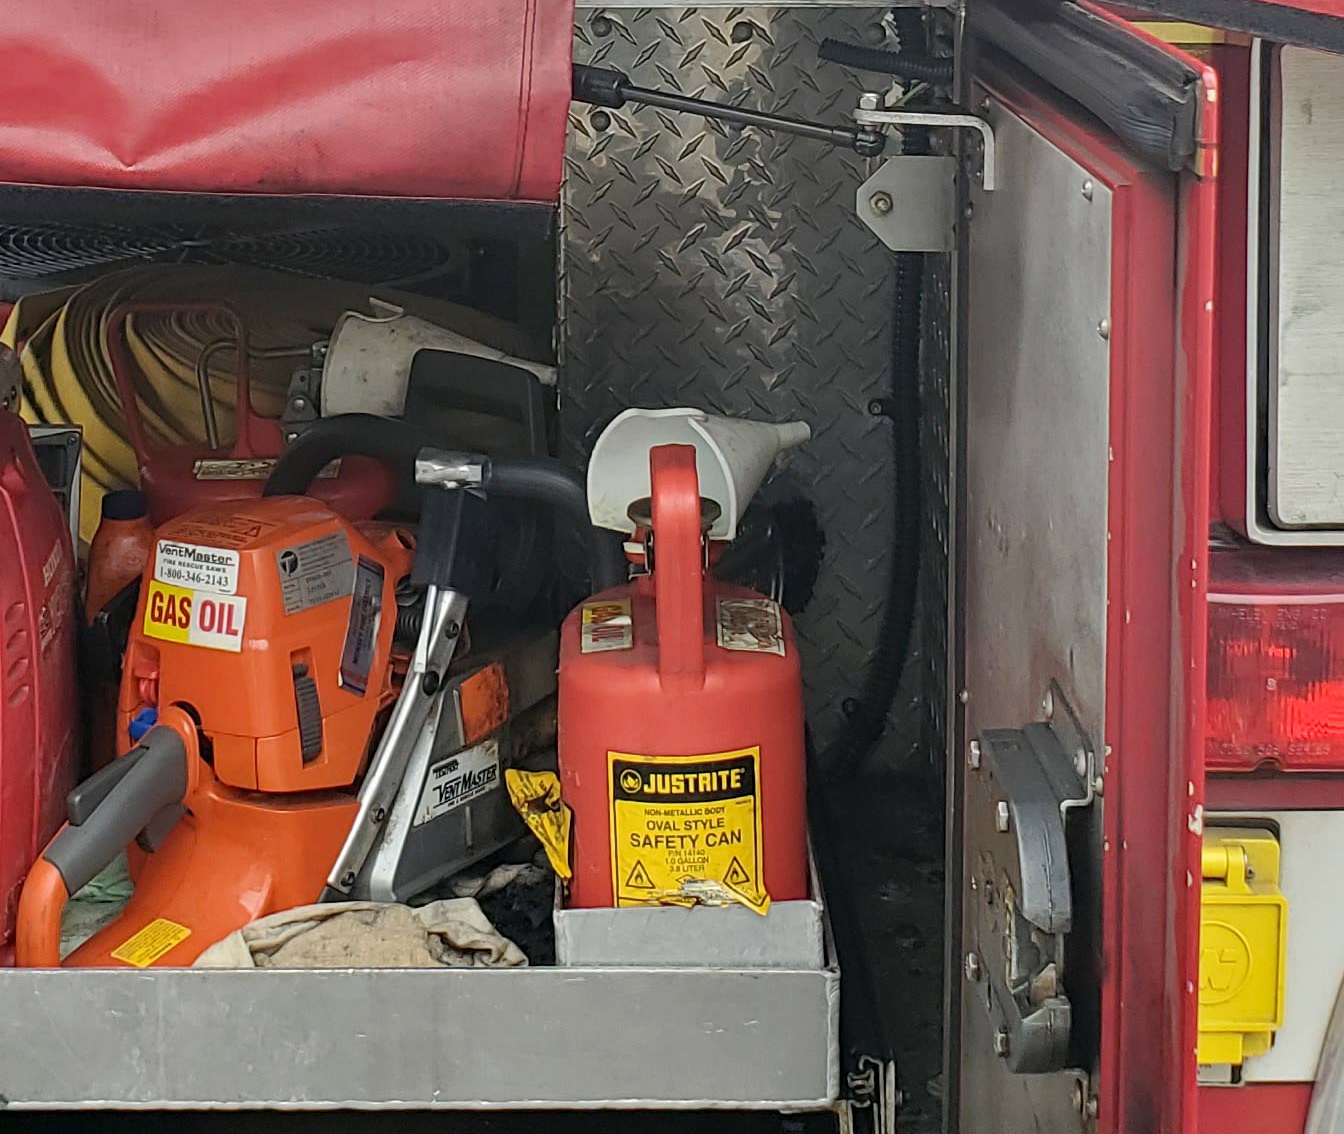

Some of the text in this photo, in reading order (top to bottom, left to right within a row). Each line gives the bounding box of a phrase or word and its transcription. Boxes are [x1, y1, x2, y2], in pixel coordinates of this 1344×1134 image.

[159, 542, 235, 565] VentMaster
[178, 560, 203, 570] RESCUE
[206, 565, 226, 573] SAWS
[160, 566, 229, 587] 1-800-346-2143
[150, 590, 239, 636] GAS OIL
[644, 806, 726, 817] NON-METALLIC BODY
[646, 817, 725, 831] OVAL STYLE
[630, 829, 742, 849] SAFETY CAN
[677, 856, 709, 864] GALLON
[683, 864, 705, 872] LITER
